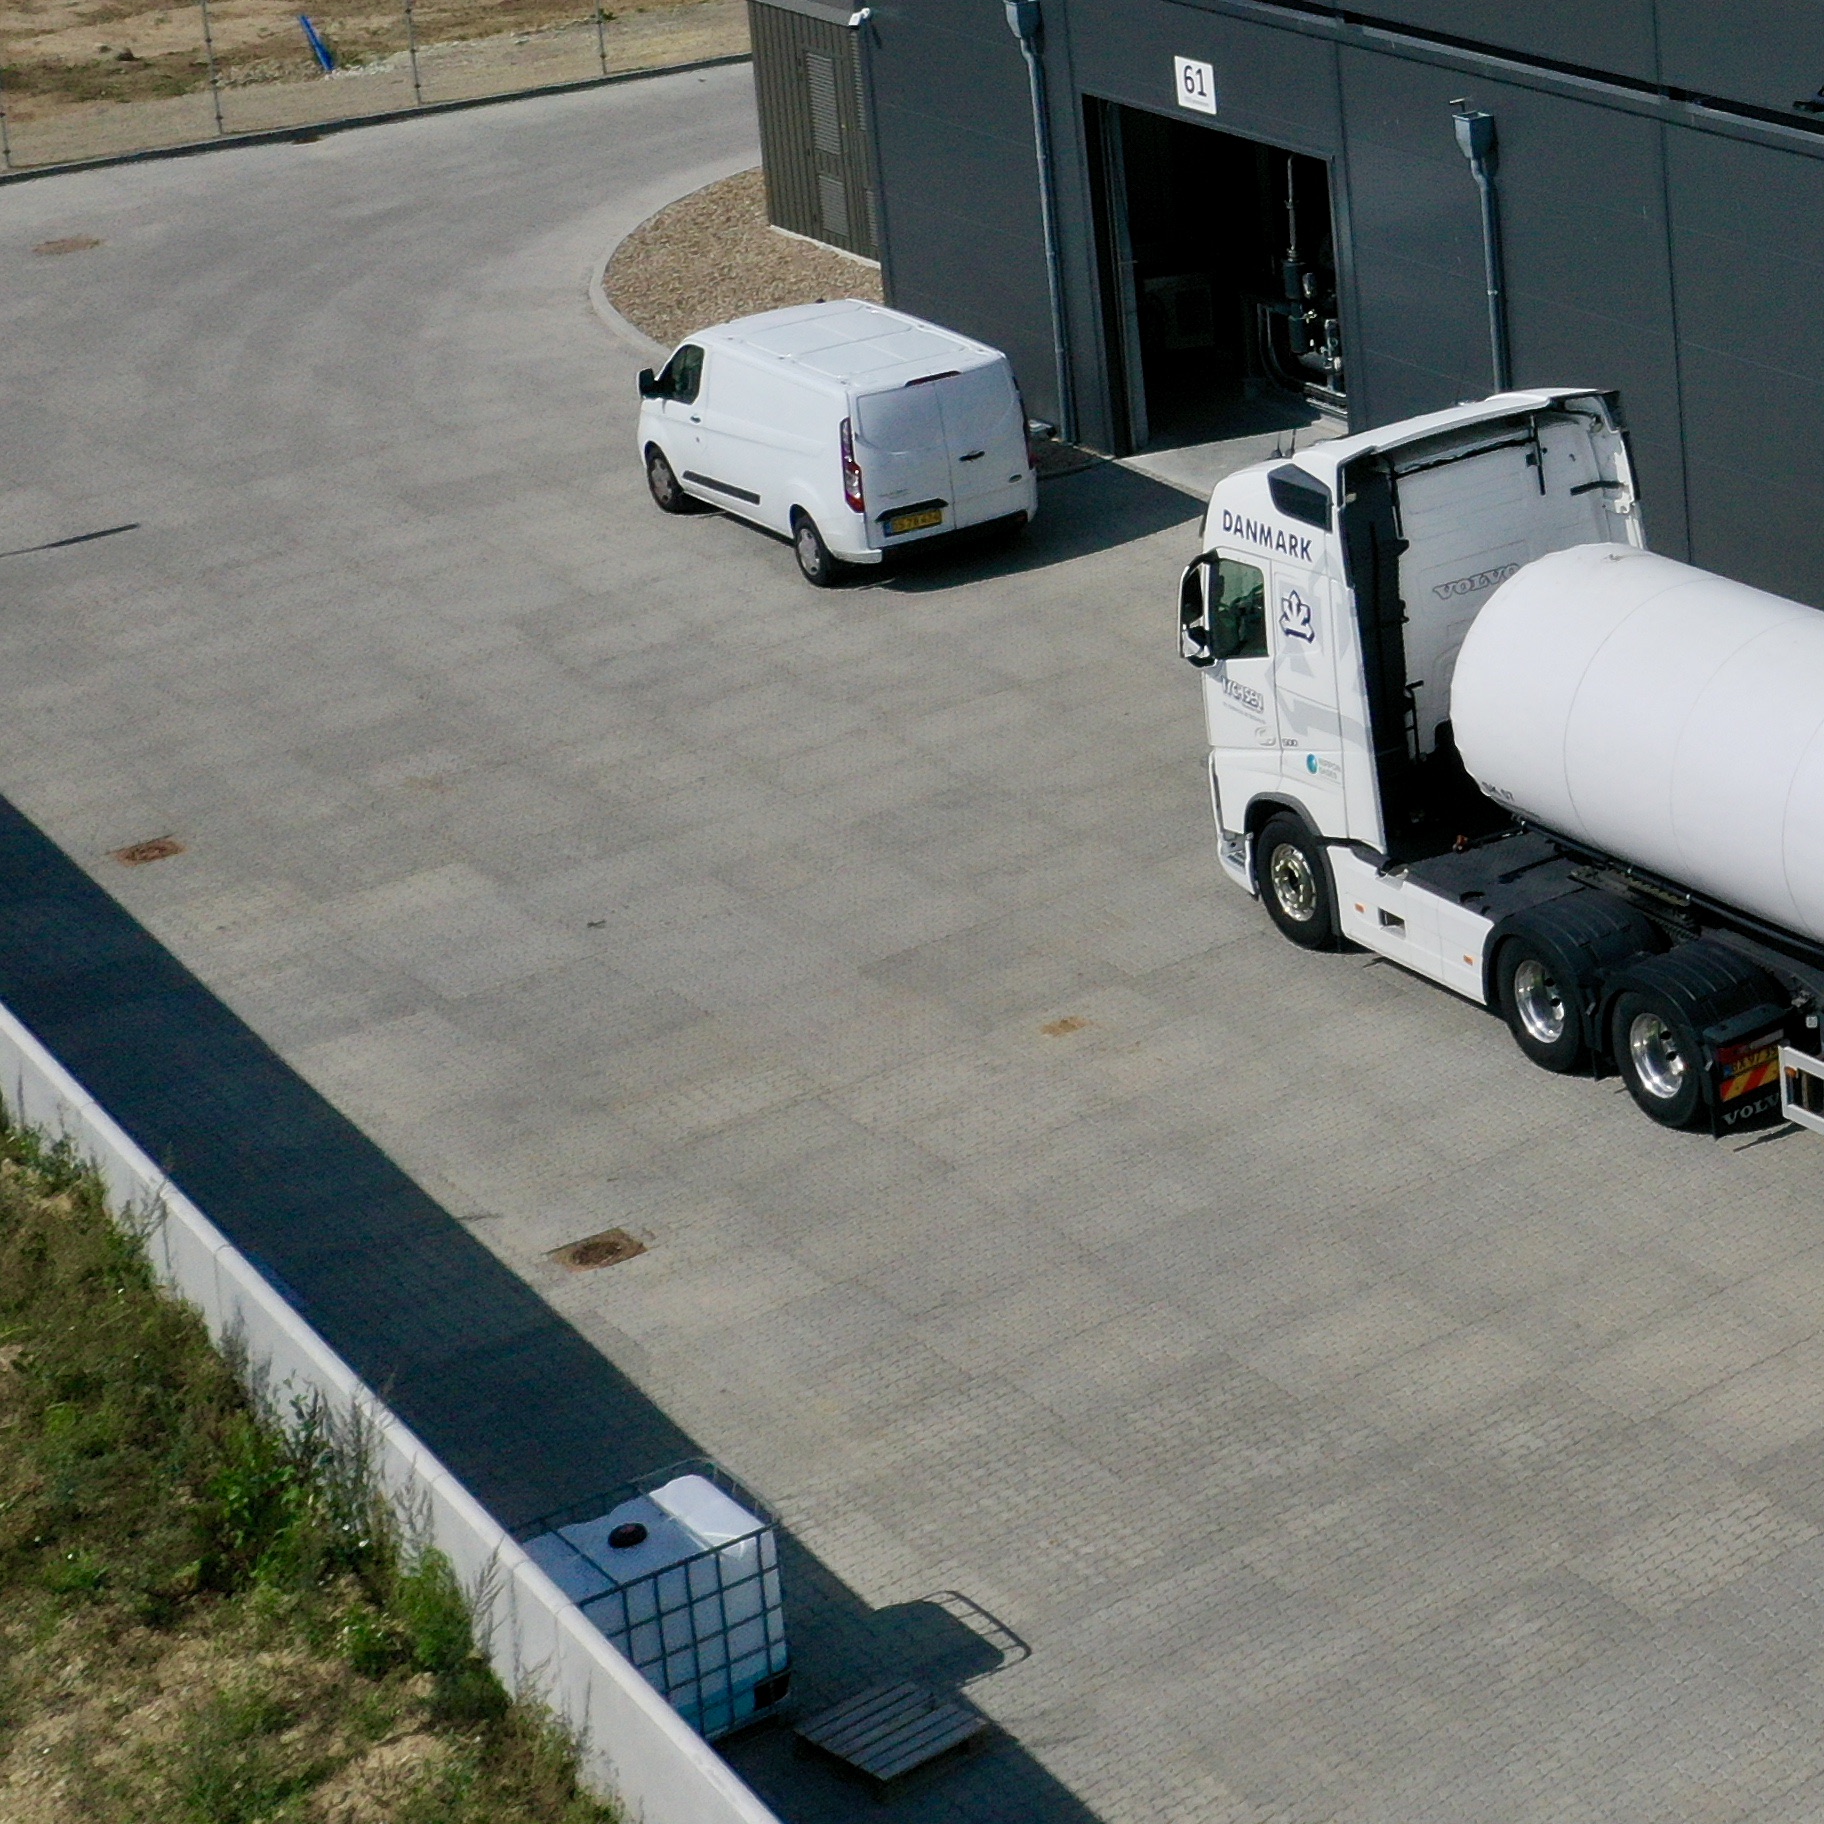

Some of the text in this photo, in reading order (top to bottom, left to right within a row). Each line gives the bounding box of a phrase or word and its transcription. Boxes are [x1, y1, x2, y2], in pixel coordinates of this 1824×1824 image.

[1184, 65, 1207, 97] 61
[1223, 509, 1312, 563] DANMARK
[1432, 562, 1520, 600] VOLVO
[1722, 1093, 1779, 1125] VOLV
